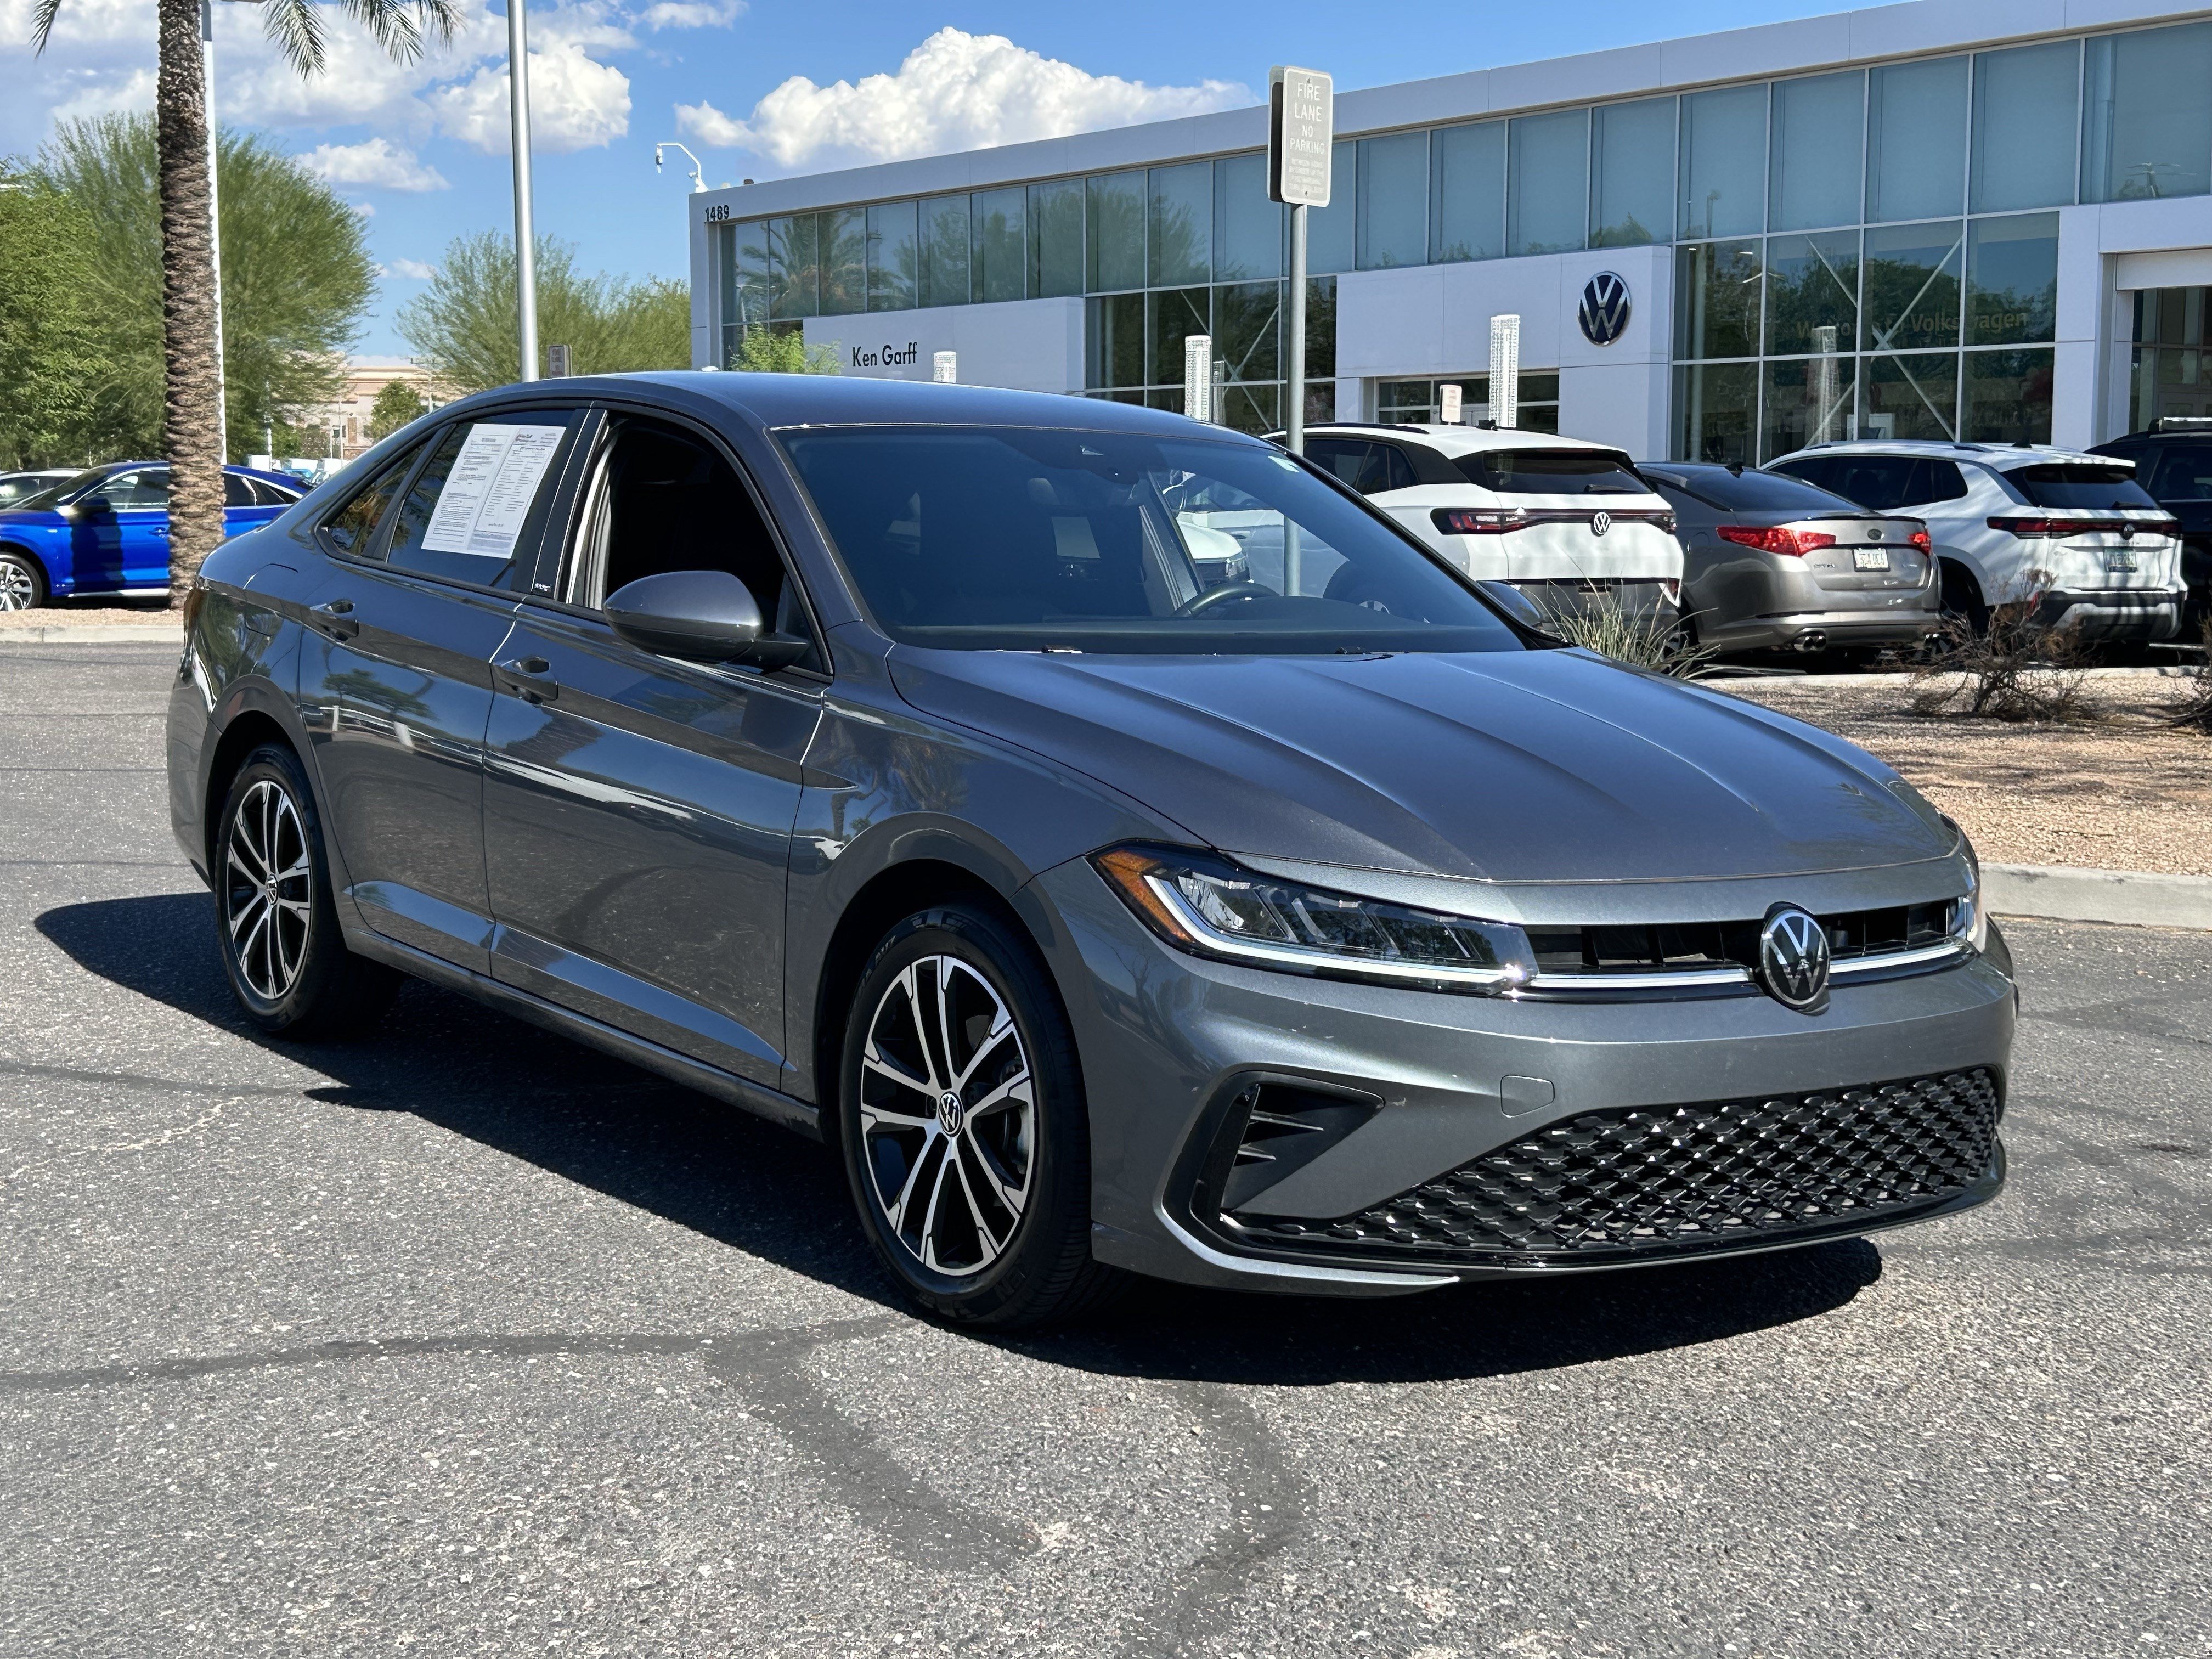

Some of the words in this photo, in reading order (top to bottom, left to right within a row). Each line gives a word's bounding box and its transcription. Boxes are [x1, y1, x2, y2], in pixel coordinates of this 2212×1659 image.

[1297, 82, 1321, 101] FIRE
[1294, 102, 1322, 122] LANE
[1302, 125, 1313, 137] NO
[1290, 138, 1325, 155] PARKING
[705, 204, 729, 222] 1489
[1578, 272, 1631, 343] VW
[853, 346, 877, 366] Ken
[882, 341, 917, 365] Garff
[1593, 512, 1611, 534] VW
[1761, 911, 1829, 1001] VW
